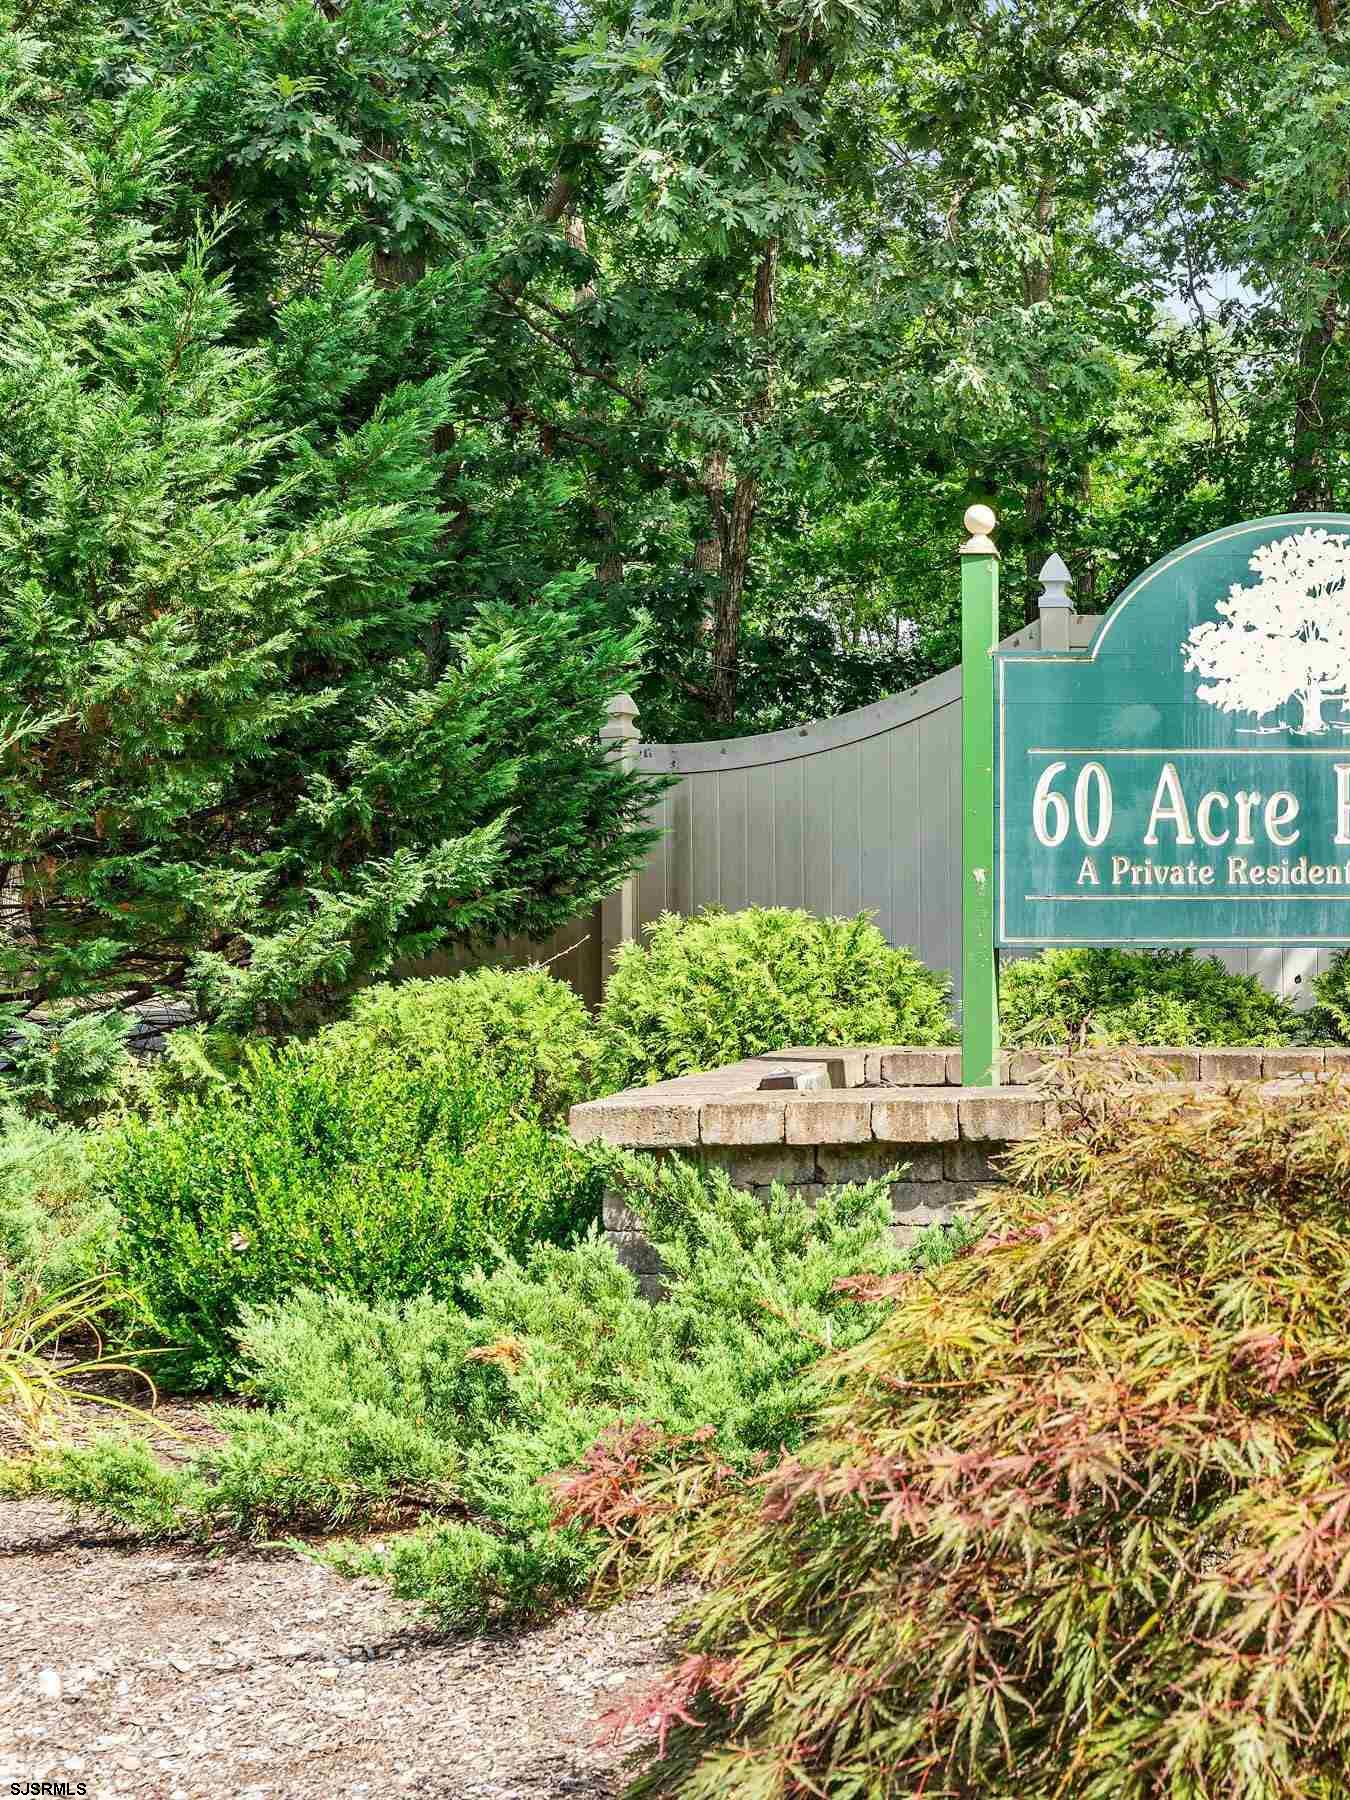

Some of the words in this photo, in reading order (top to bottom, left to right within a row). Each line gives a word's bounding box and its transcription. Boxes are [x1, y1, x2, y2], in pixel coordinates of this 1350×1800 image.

[1032, 761, 1112, 847] 60
[1144, 763, 1300, 846] Acre
[1077, 857, 1100, 885] A
[1112, 855, 1214, 885] Private
